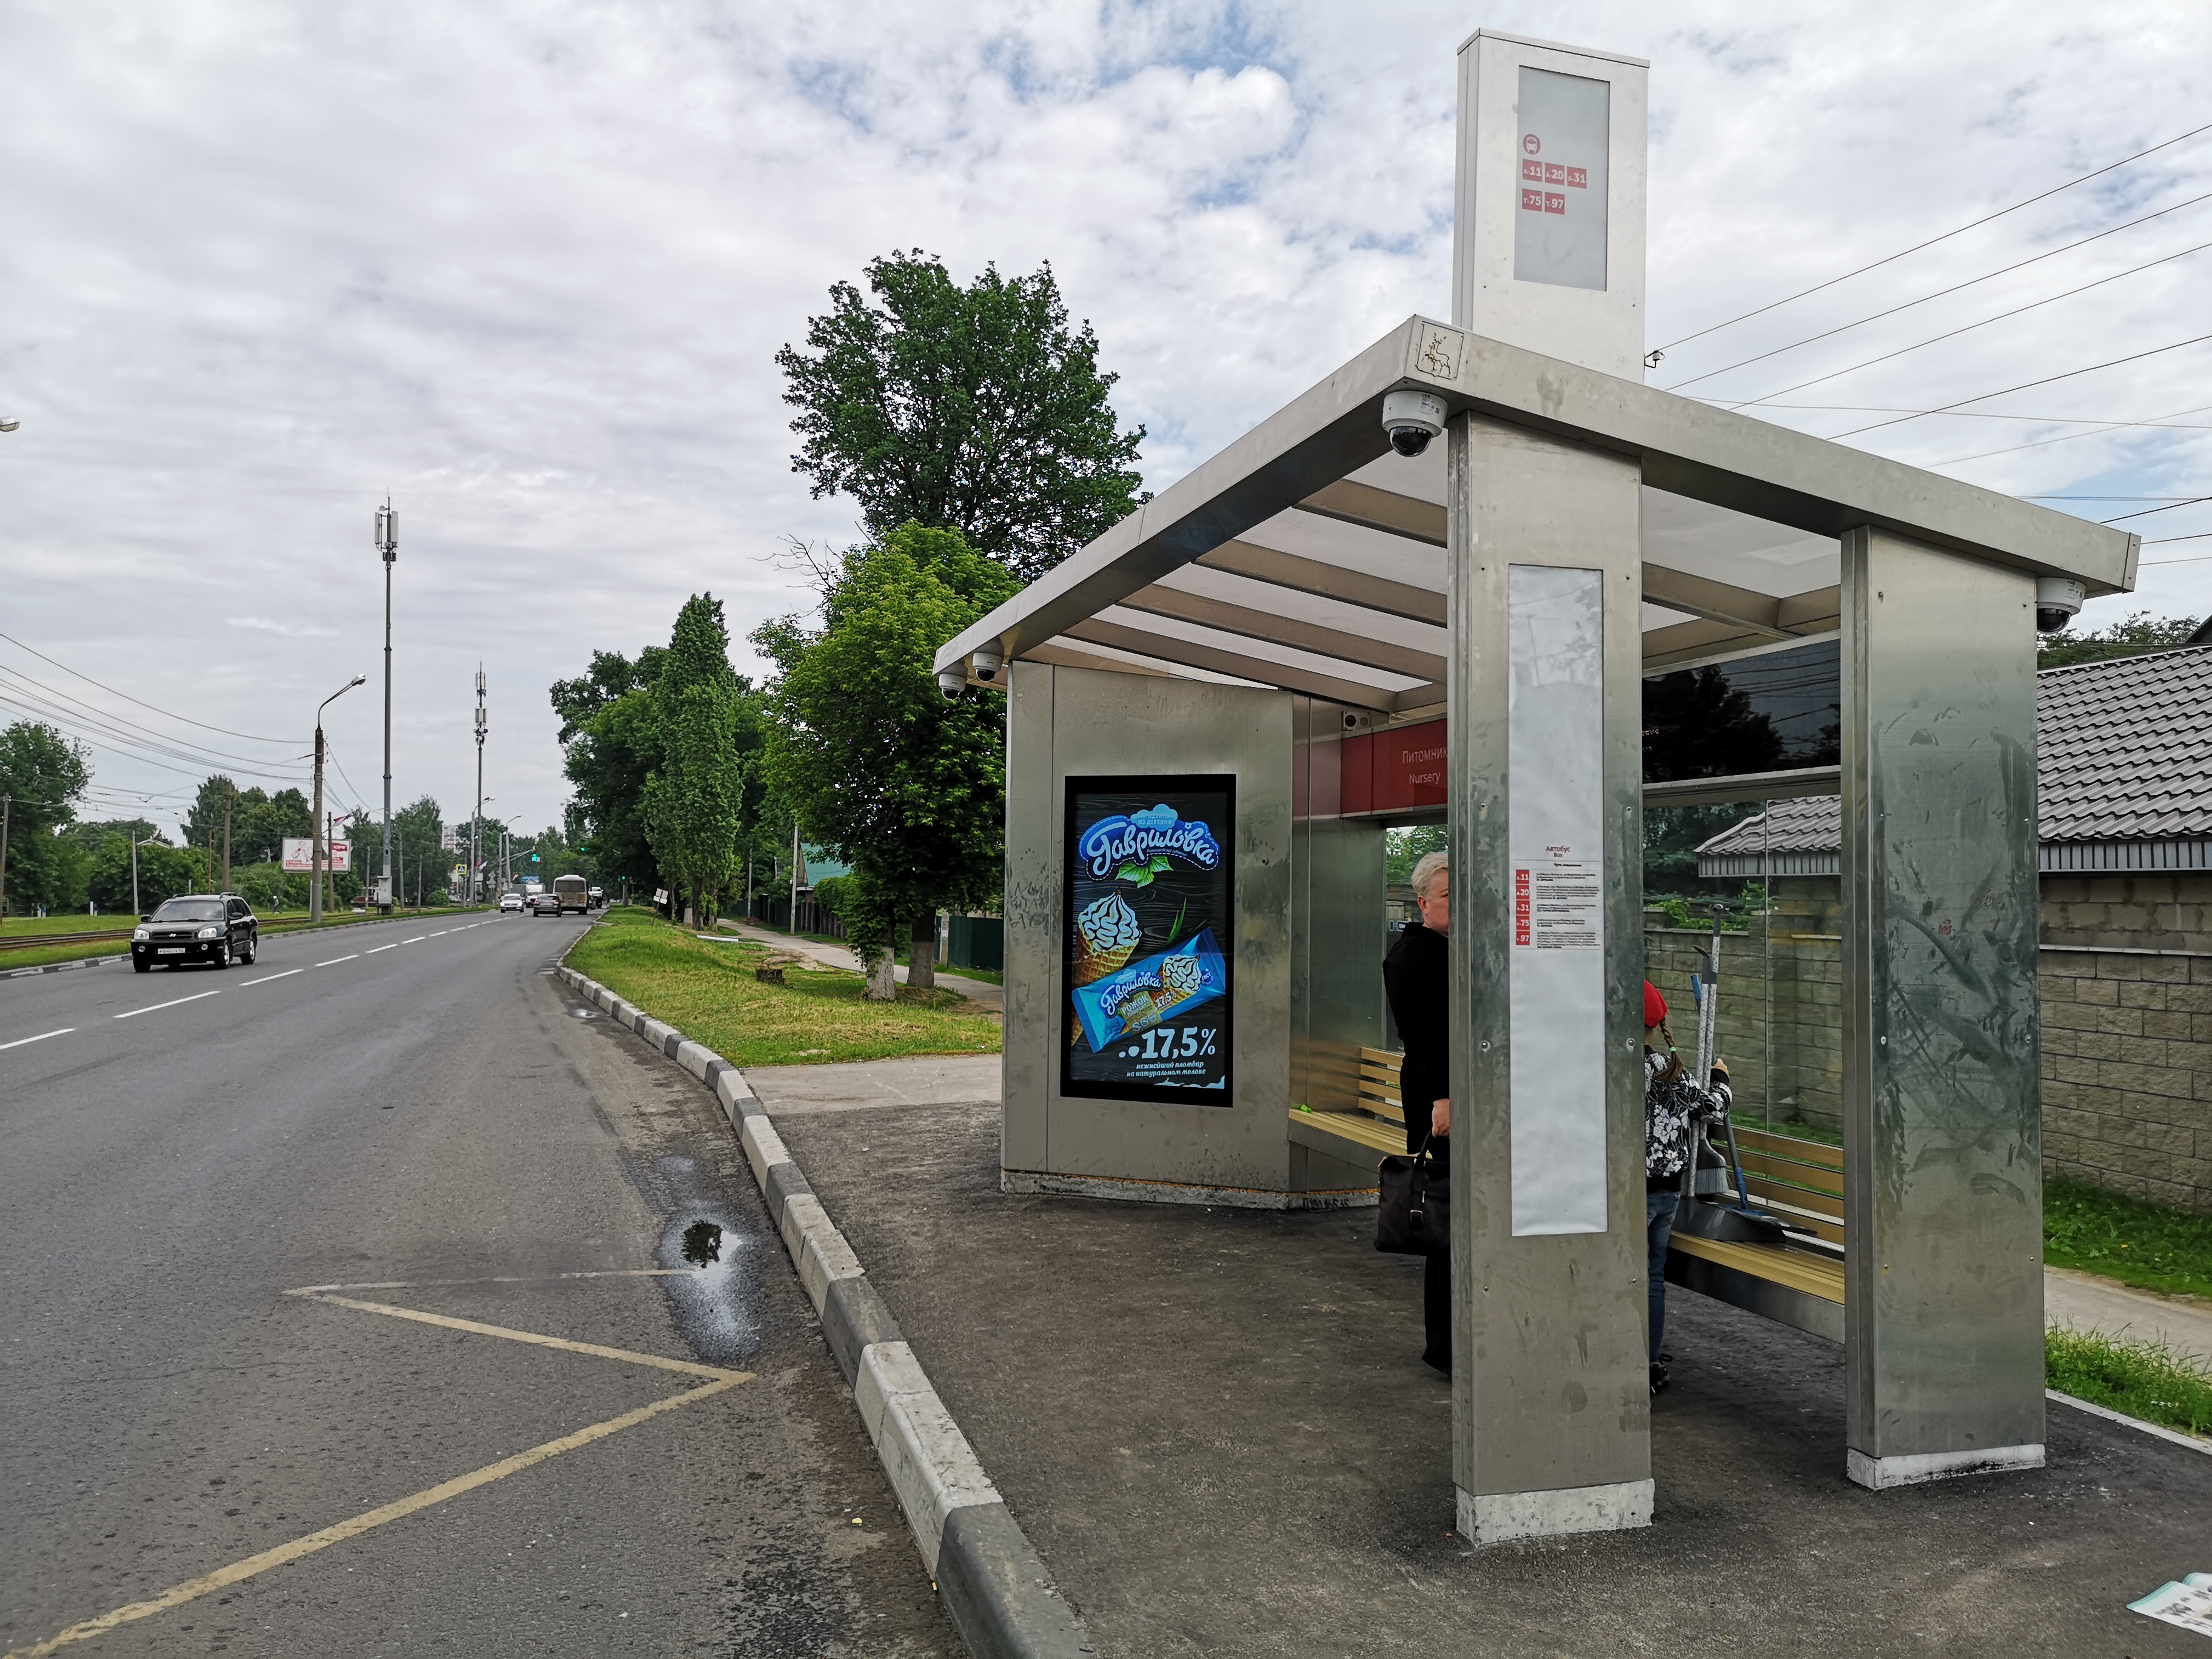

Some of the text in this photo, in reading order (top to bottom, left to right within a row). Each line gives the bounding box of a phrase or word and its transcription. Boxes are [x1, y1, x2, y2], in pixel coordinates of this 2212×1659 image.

[1523, 166, 1541, 177] А-11
[1546, 169, 1564, 181] А-20
[1523, 195, 1564, 209] Т-75 Т-97
[1402, 746, 1447, 764] Питомник
[1409, 771, 1441, 785] Nursery
[1086, 821, 1215, 876] Гавриловка
[1100, 971, 1161, 1016] Гавриловка
[1121, 994, 1149, 1015] РОЖОК
[1175, 1060, 1204, 1068] пломбир
[1135, 1069, 1182, 1078] натуральном
